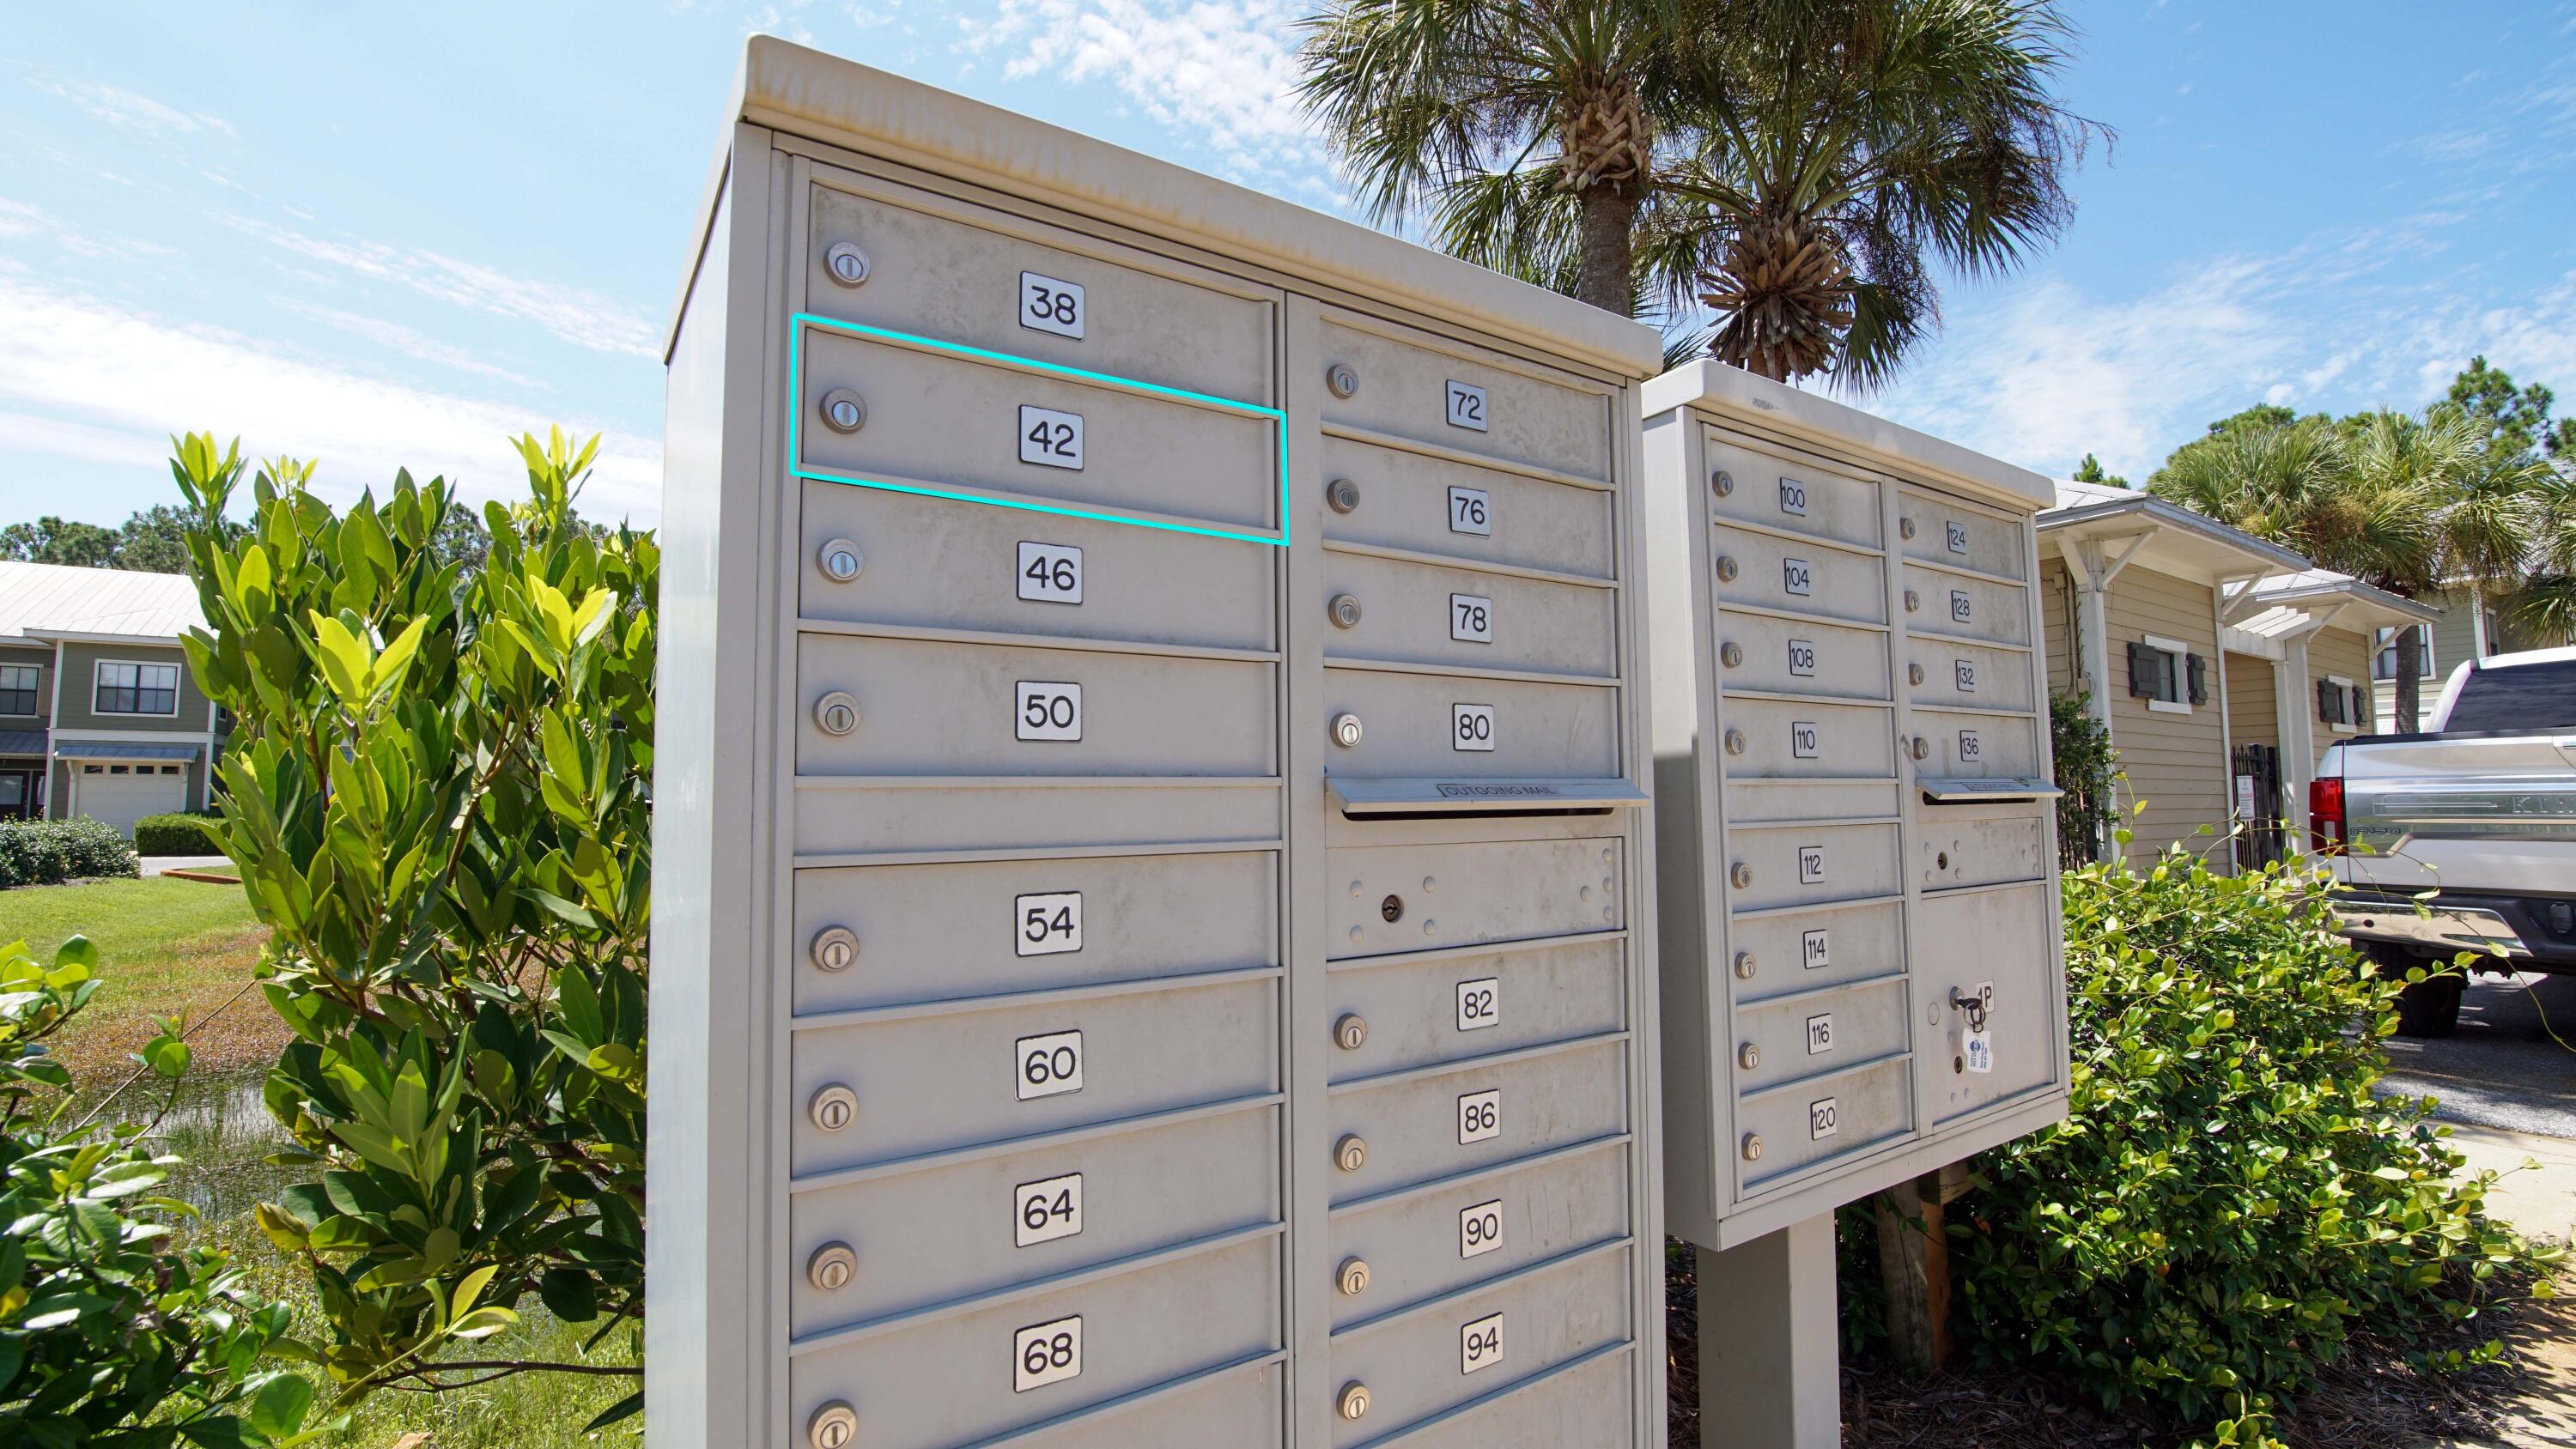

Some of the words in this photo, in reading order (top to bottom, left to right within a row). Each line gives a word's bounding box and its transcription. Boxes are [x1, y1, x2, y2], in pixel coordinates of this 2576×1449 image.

[1030, 286, 1075, 324] 38
[1453, 391, 1481, 421] 72
[1029, 421, 1076, 457] 42
[1455, 498, 1485, 524] 76
[1782, 486, 1805, 508] 100
[1949, 529, 1965, 546] 124
[1026, 556, 1075, 591] 46
[1786, 567, 1809, 588] 104
[1458, 604, 1485, 632] 78
[1953, 598, 1970, 616] 128
[1791, 648, 1814, 669] 108
[1959, 667, 1974, 685] 132
[1025, 694, 1073, 728] 50
[1459, 713, 1490, 741] 80
[1797, 730, 1815, 749] 110
[1962, 737, 1978, 755] 136
[1446, 786, 1522, 796] OUTGOING
[1522, 786, 1558, 795] MAIL
[1805, 855, 1821, 875] 112
[1026, 906, 1074, 942] 54
[1807, 938, 1826, 959] 114
[1465, 990, 1493, 1019] 82
[1813, 1023, 1829, 1045] 116
[1026, 1046, 1075, 1084] 60
[1466, 1102, 1495, 1132] 86
[1814, 1107, 1836, 1130] 120
[1024, 1189, 1074, 1229] 64
[1467, 1214, 1498, 1246] 90
[1024, 1333, 1072, 1374] 68
[1467, 1327, 1498, 1361] 94
